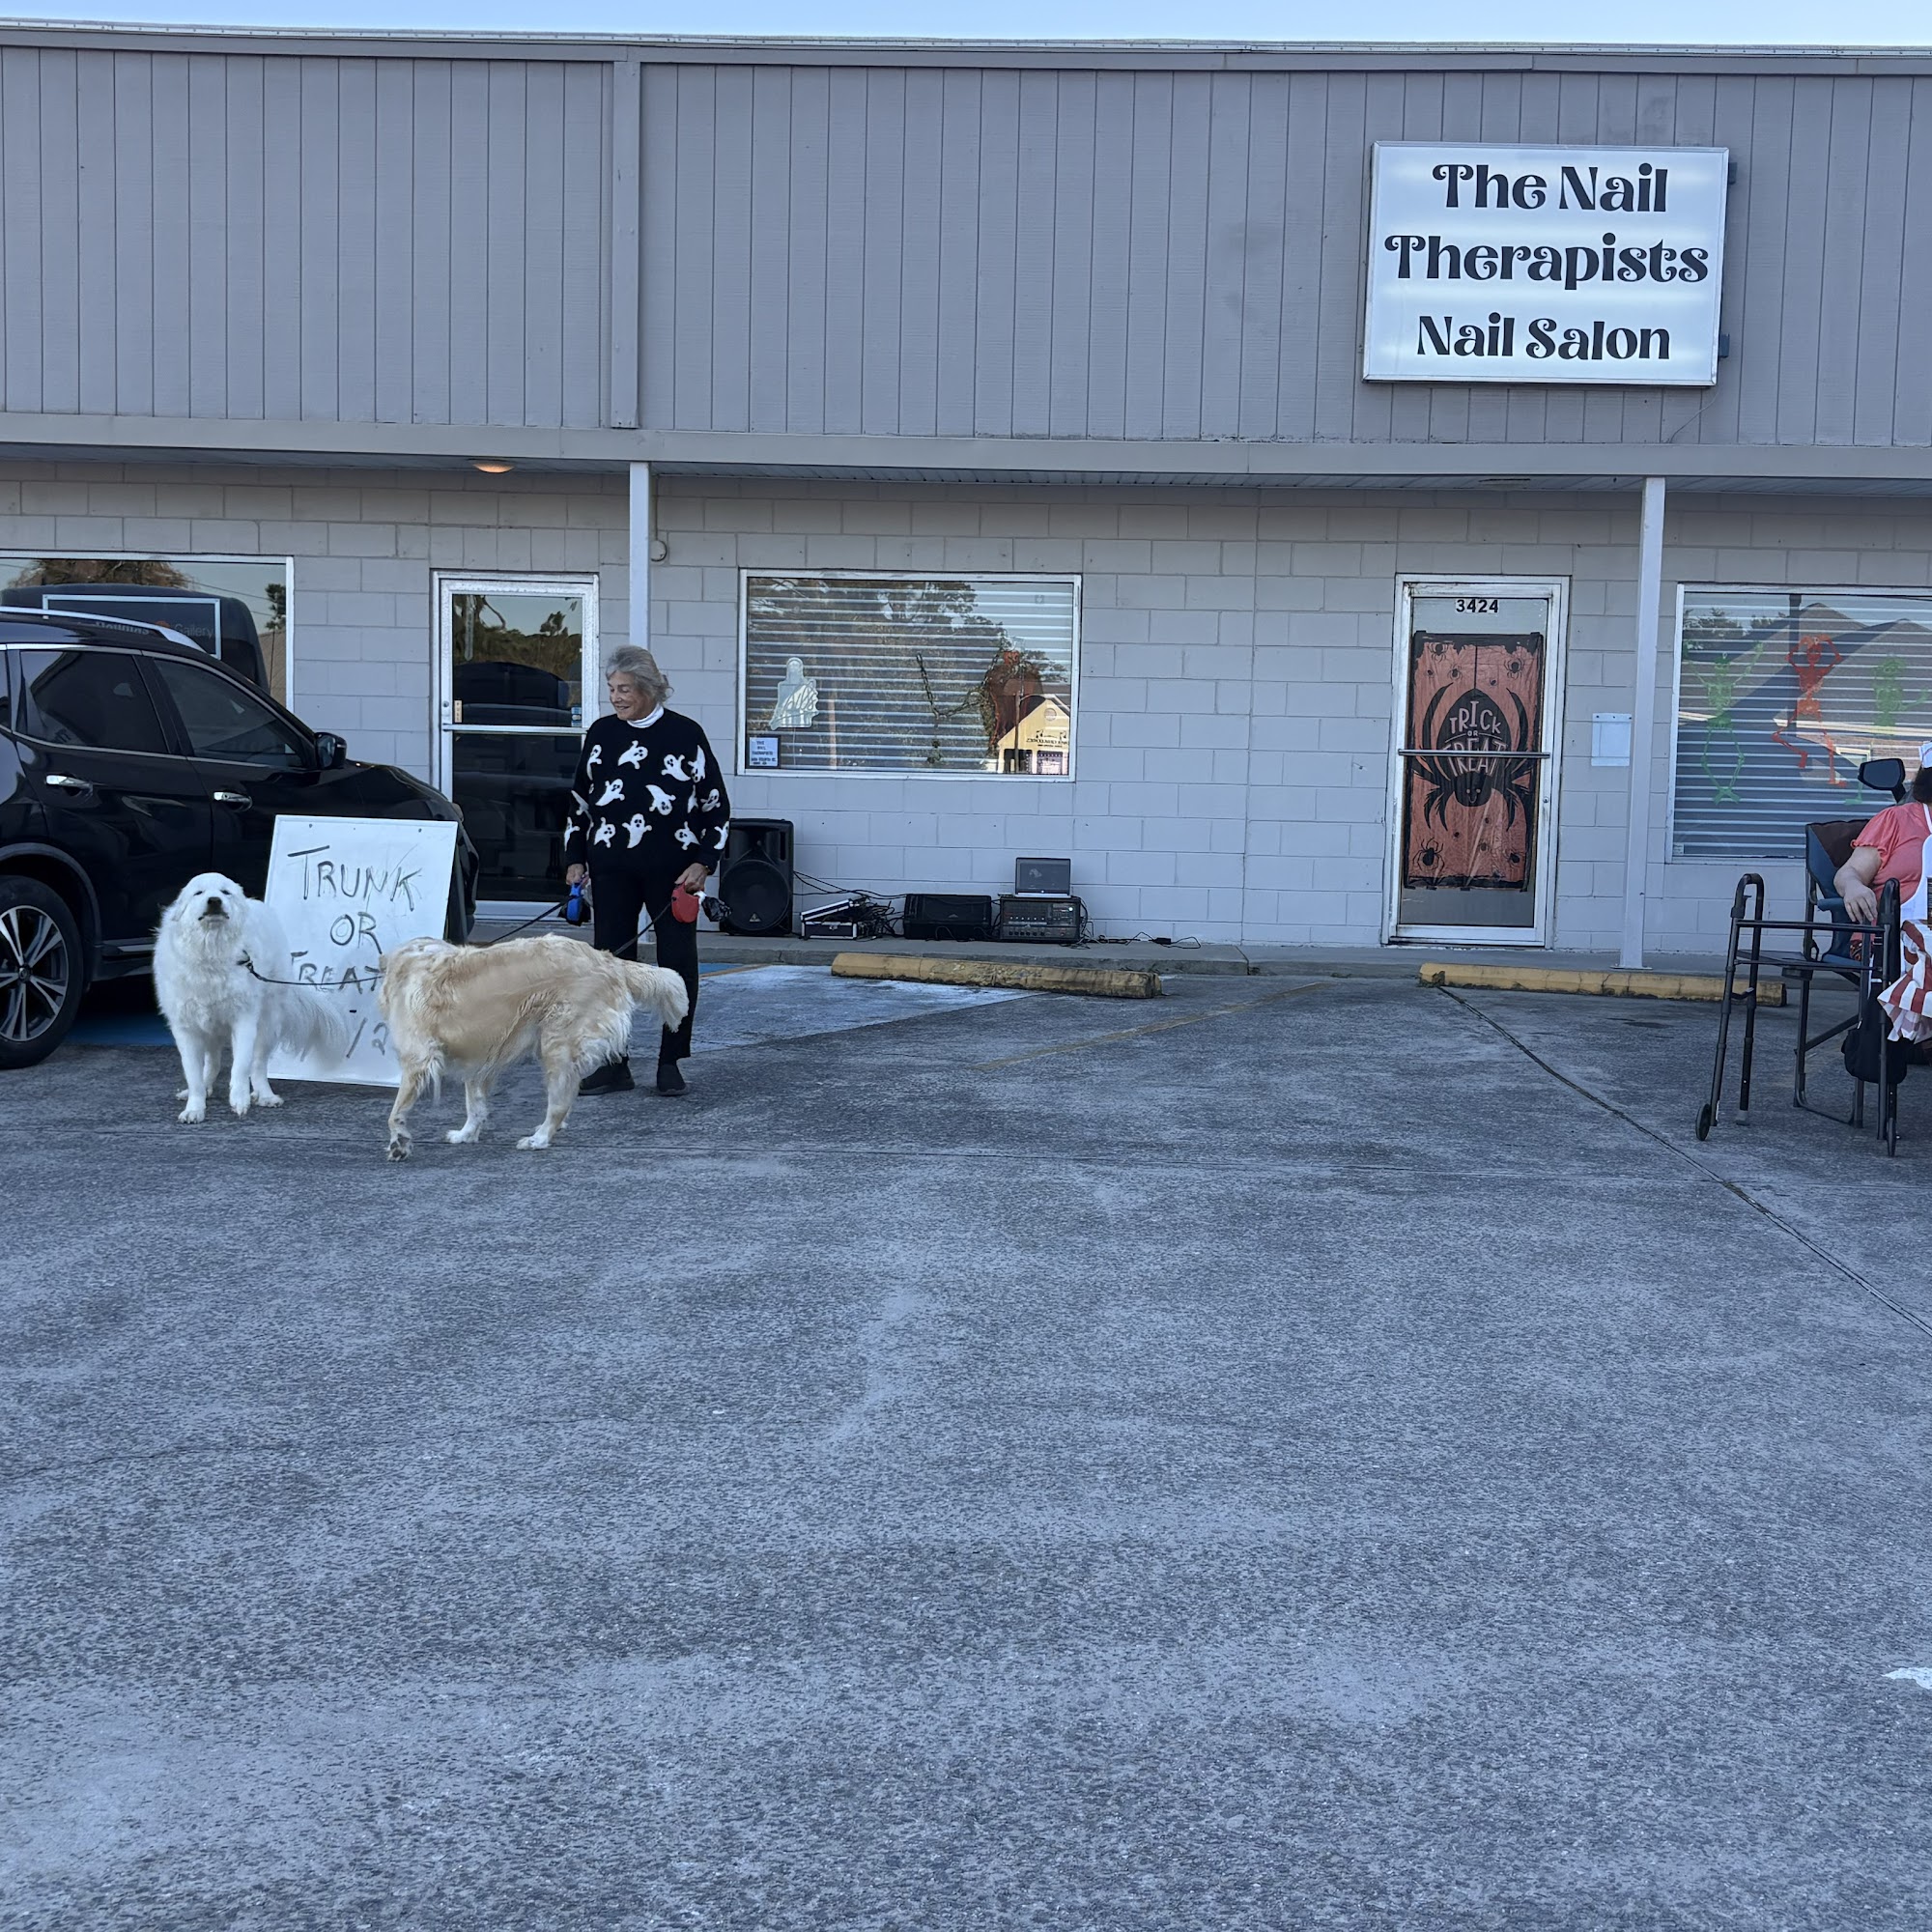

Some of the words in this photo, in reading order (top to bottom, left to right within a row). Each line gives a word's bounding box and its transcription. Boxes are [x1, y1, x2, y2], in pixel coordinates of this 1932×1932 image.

[1432, 163, 1546, 210] The
[1558, 162, 1668, 213] Nail
[1384, 232, 1709, 290] Therapists
[1417, 312, 1516, 357] Nail
[1525, 318, 1671, 360] Salon
[1456, 599, 1499, 613] 3424
[1449, 700, 1502, 734] TRICK
[287, 845, 423, 912] TRUNK
[329, 911, 383, 954] OR
